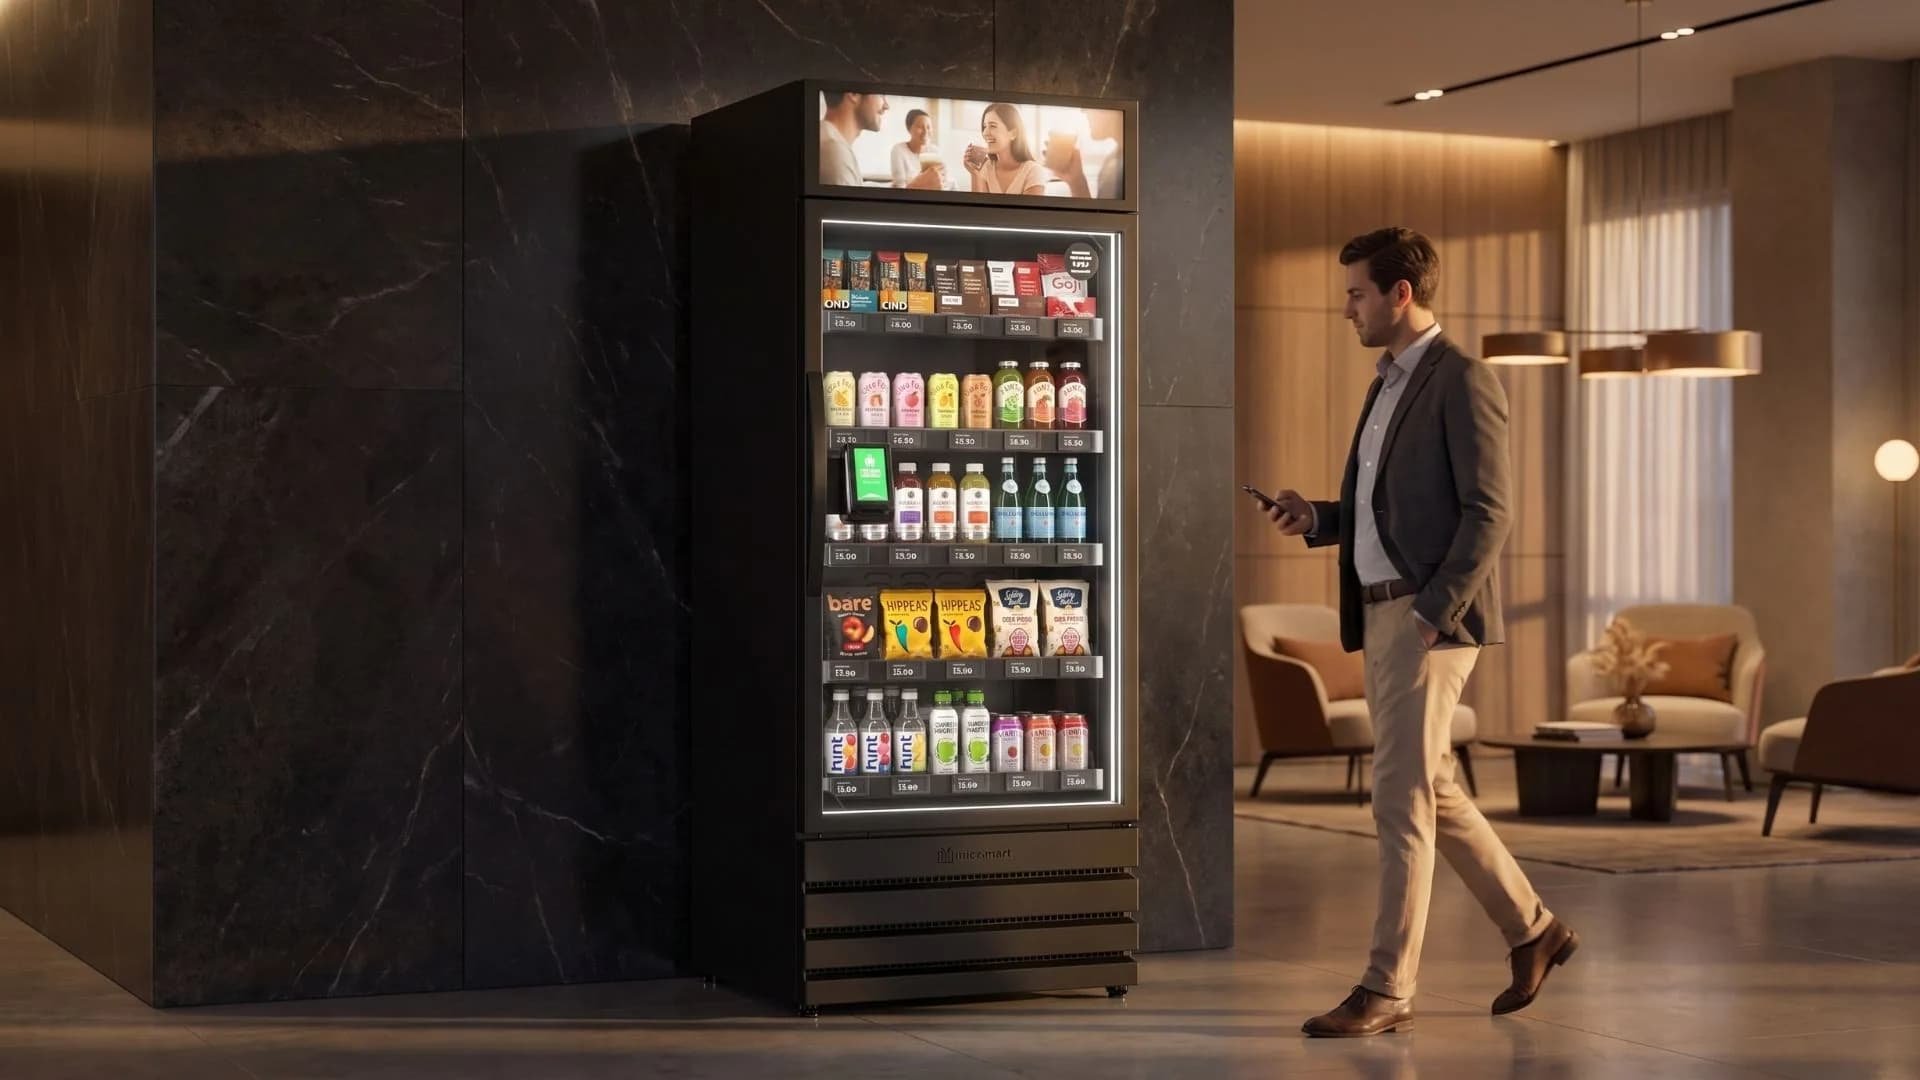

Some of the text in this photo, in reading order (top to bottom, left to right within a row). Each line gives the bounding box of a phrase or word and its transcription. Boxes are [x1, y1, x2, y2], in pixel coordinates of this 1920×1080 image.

[827, 594, 872, 612] bare
[886, 600, 928, 612] HIPPEAS
[941, 600, 981, 612] HIPPEAS
[831, 736, 844, 772] hint
[865, 735, 878, 770] hint
[900, 735, 913, 769] hint
